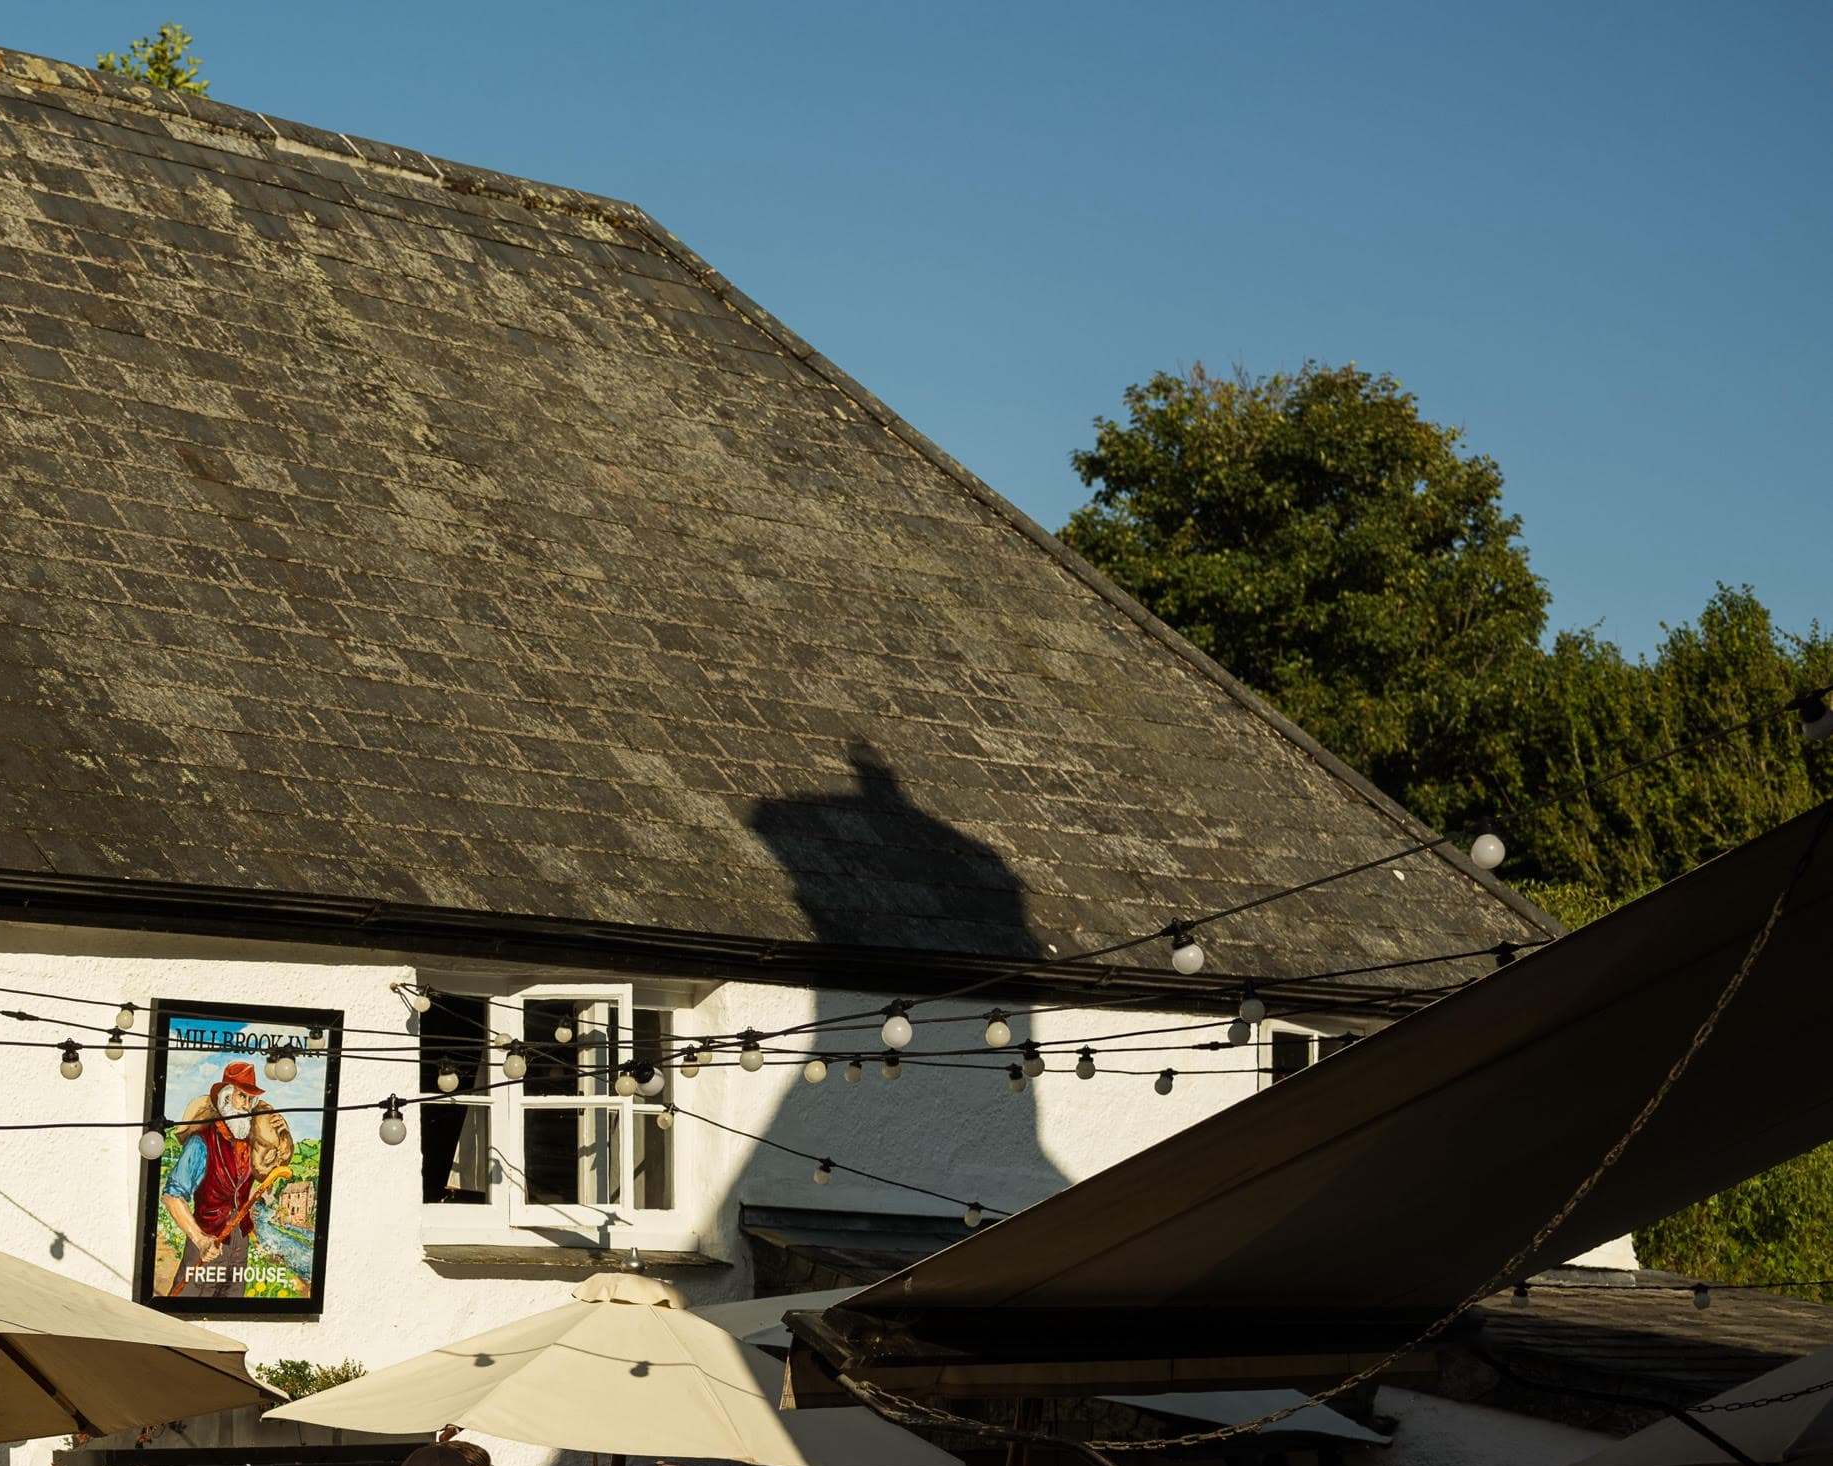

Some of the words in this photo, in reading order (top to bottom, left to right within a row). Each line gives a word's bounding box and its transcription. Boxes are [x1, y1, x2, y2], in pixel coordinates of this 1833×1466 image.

[175, 1028, 281, 1056] MILLBROOK
[287, 1035, 321, 1059] IN
[185, 1266, 227, 1283] FREE
[232, 1266, 287, 1283] HOUSE
